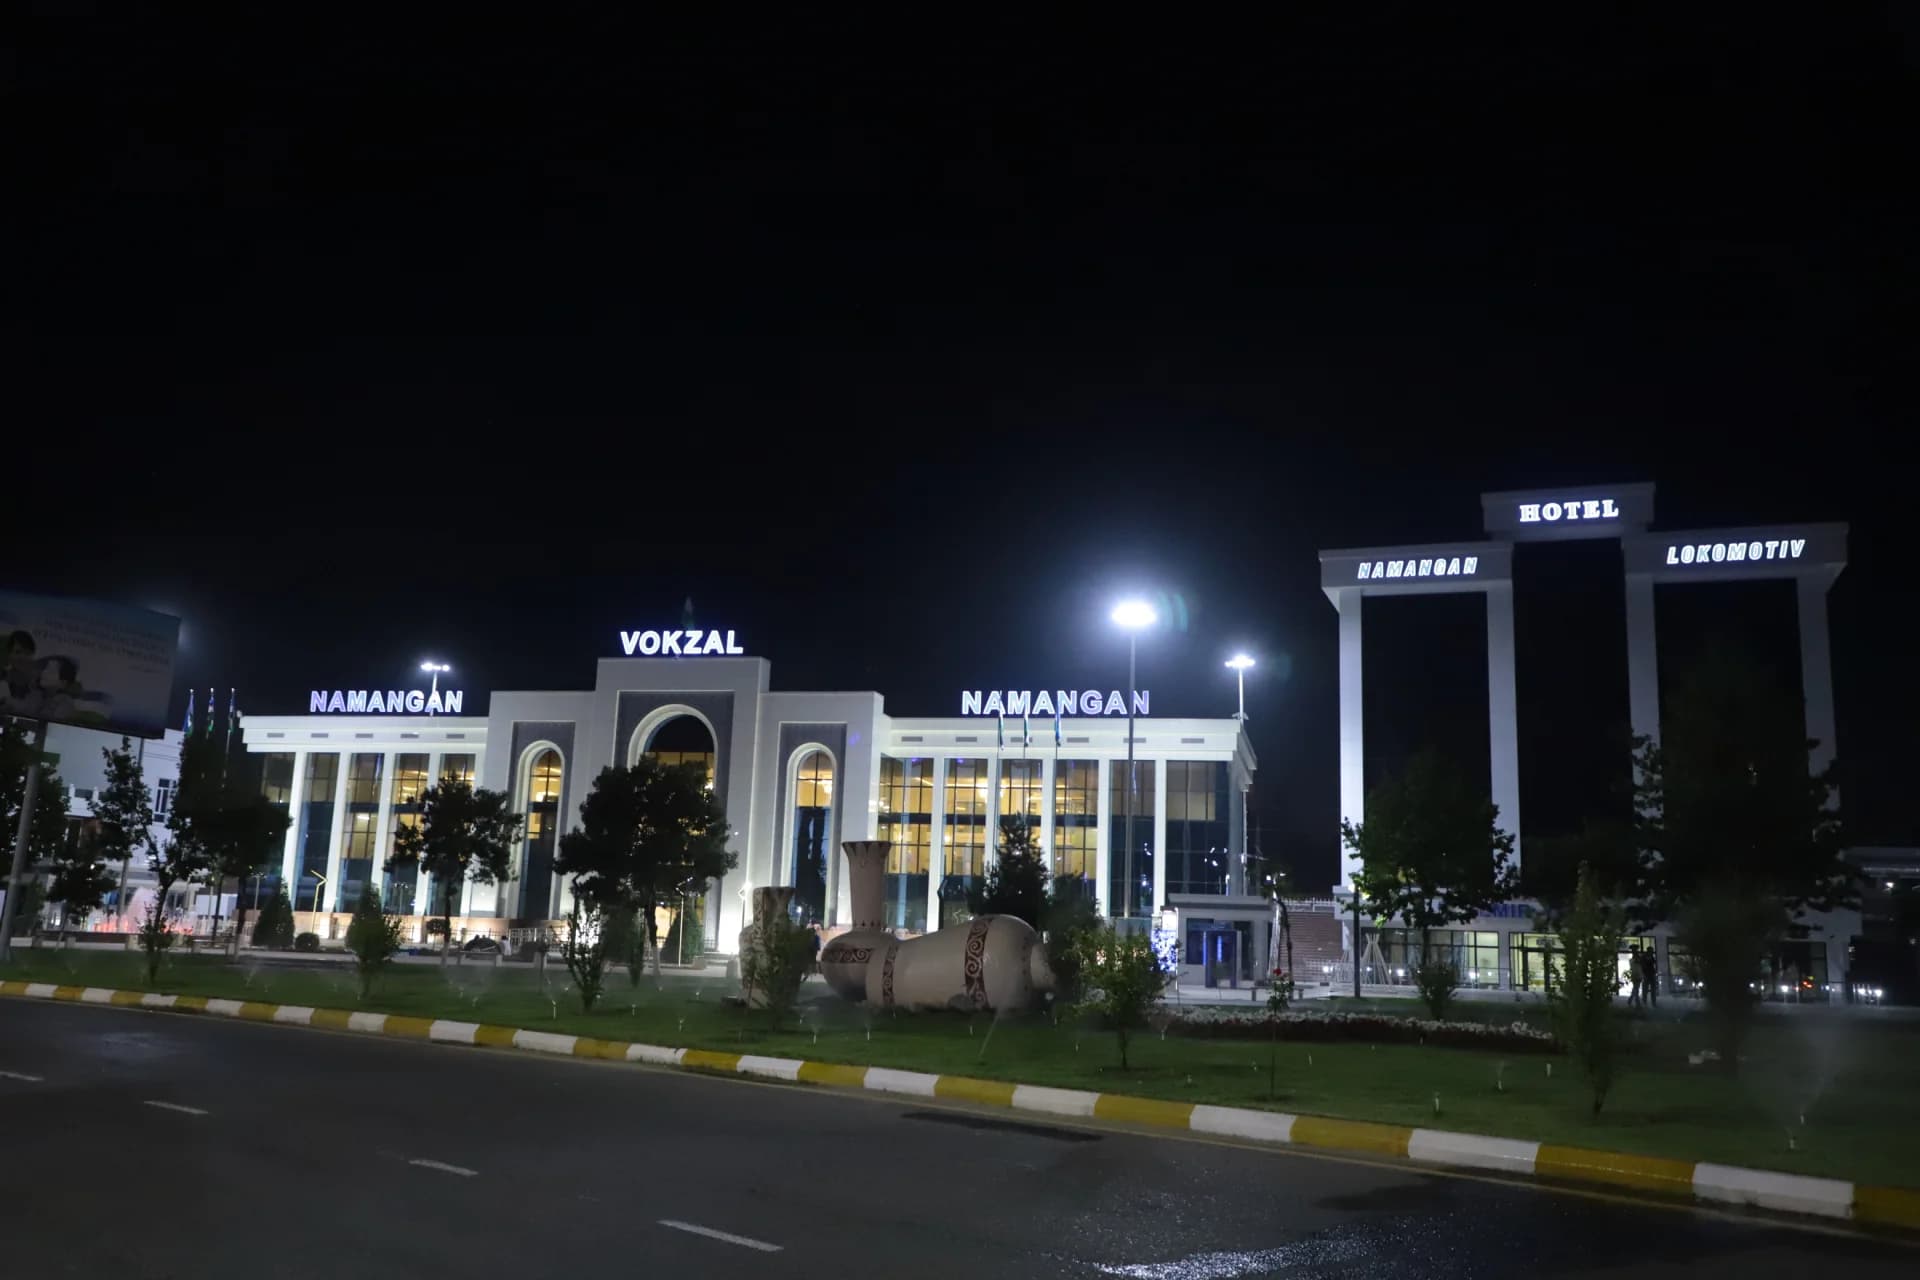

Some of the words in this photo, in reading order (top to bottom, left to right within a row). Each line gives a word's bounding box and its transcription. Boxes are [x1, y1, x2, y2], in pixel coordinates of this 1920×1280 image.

[1519, 499, 1619, 523] HOTEL
[1666, 539, 1806, 565] LOKOMOTIV
[1357, 557, 1478, 579] NAMANGAN
[620, 630, 744, 654] VOKZAL
[309, 690, 463, 713] NAMANGAN
[961, 690, 1150, 715] NAMANGAN
